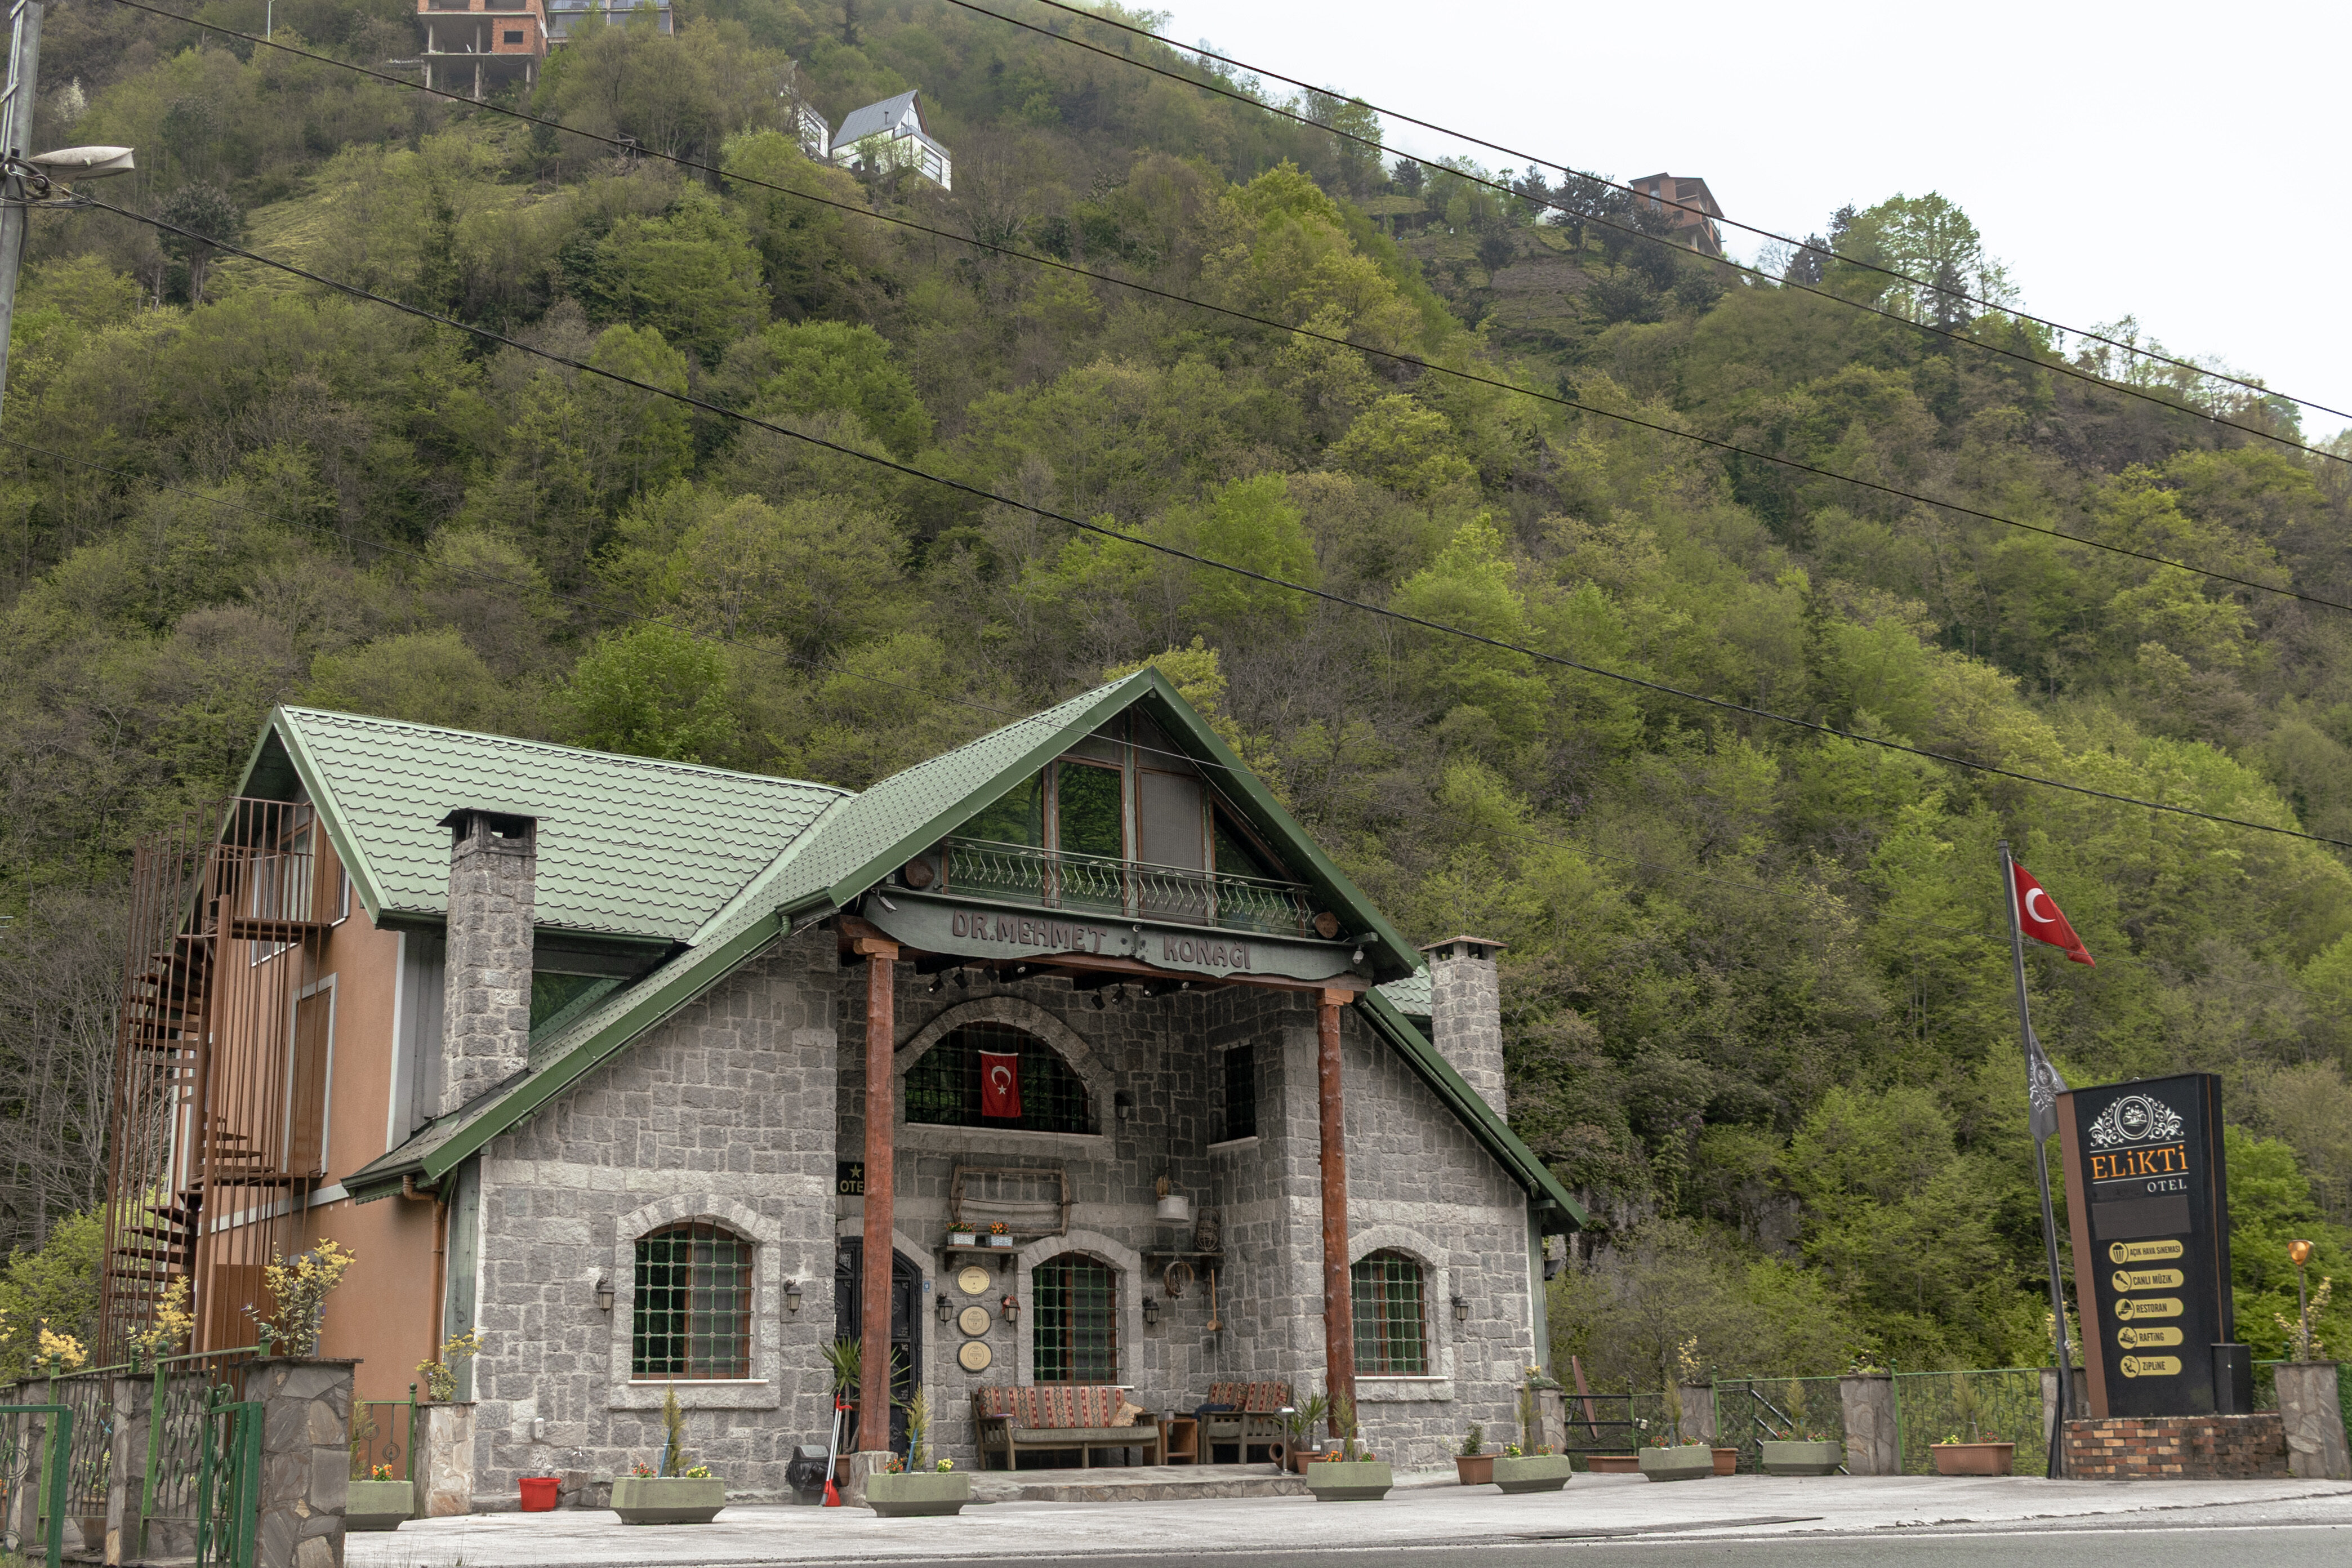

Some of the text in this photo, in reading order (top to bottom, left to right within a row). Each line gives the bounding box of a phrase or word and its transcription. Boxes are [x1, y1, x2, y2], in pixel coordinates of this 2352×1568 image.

[1164, 936, 1251, 969] KONAĞI
[840, 1180, 864, 1193] OTE
[2147, 1178, 2188, 1193] OTEL
[2130, 1248, 2142, 1257] AÇIK
[2142, 1246, 2156, 1255] HAVA
[2133, 1276, 2151, 1285] CANLI
[2136, 1303, 2167, 1313] RESTORAN
